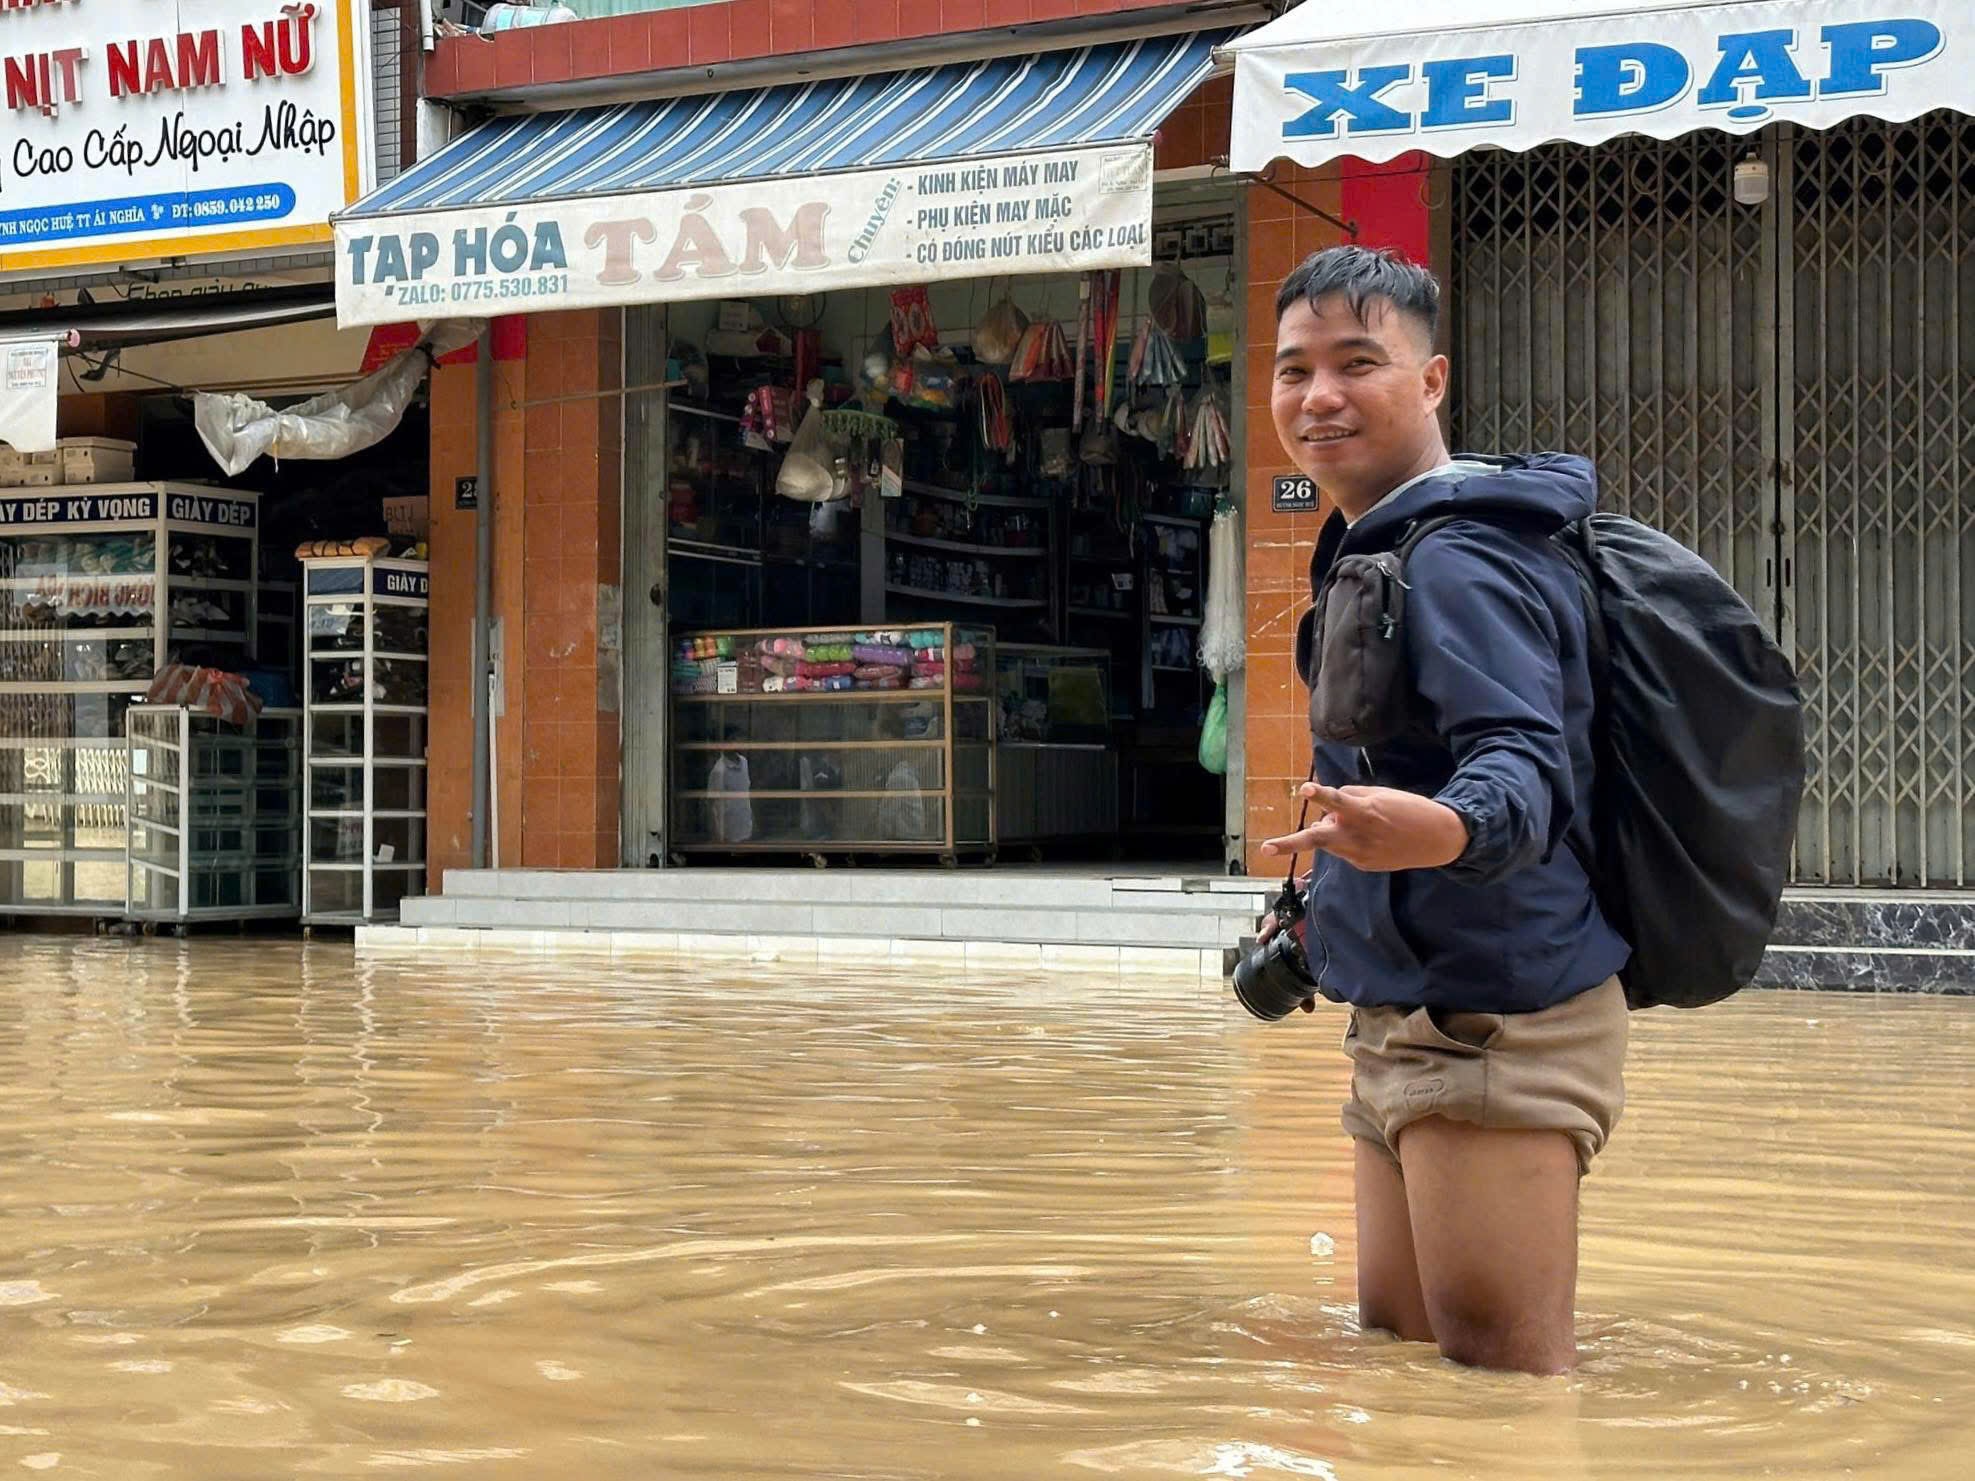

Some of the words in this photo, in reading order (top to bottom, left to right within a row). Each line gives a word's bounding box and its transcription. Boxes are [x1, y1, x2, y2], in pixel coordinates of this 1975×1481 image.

[5, 48, 87, 117] NỊT
[106, 29, 224, 97] NAM
[242, 2, 319, 80] NỮ
[1282, 54, 1517, 140] XE
[1573, 18, 1945, 123] ĐẠP
[13, 138, 73, 177] Cao
[84, 124, 143, 176] Cấp
[144, 111, 243, 172] Ngoại
[246, 100, 335, 156] Nhập
[918, 172, 956, 195] KINH
[961, 165, 998, 194] KIỆN
[1003, 161, 1039, 187] MÁY
[1044, 160, 1078, 184] MAY
[19, 218, 49, 235] NGỌC
[51, 211, 74, 232] HUỆ
[76, 213, 91, 228] TT
[918, 207, 949, 232] PHỤ
[954, 201, 991, 230] KIỆN
[996, 200, 1030, 223] MAY
[1035, 193, 1072, 222] MẶC
[453, 211, 568, 277] HÓA
[917, 238, 937, 264] CÓ
[943, 236, 985, 261] ĐÓNG
[991, 231, 1022, 257] NÚT
[1027, 224, 1064, 255] KIỂU
[1069, 225, 1103, 251] CÁC
[398, 284, 446, 305] ZALO:
[451, 274, 569, 302] 0775.530.831
[1280, 480, 1311, 499] 26
[23, 498, 59, 521] DÉP
[98, 497, 150, 520] VỌNG
[172, 496, 214, 521] GIÀY
[217, 499, 250, 525] DÉP
[387, 572, 416, 592] GIÀY
